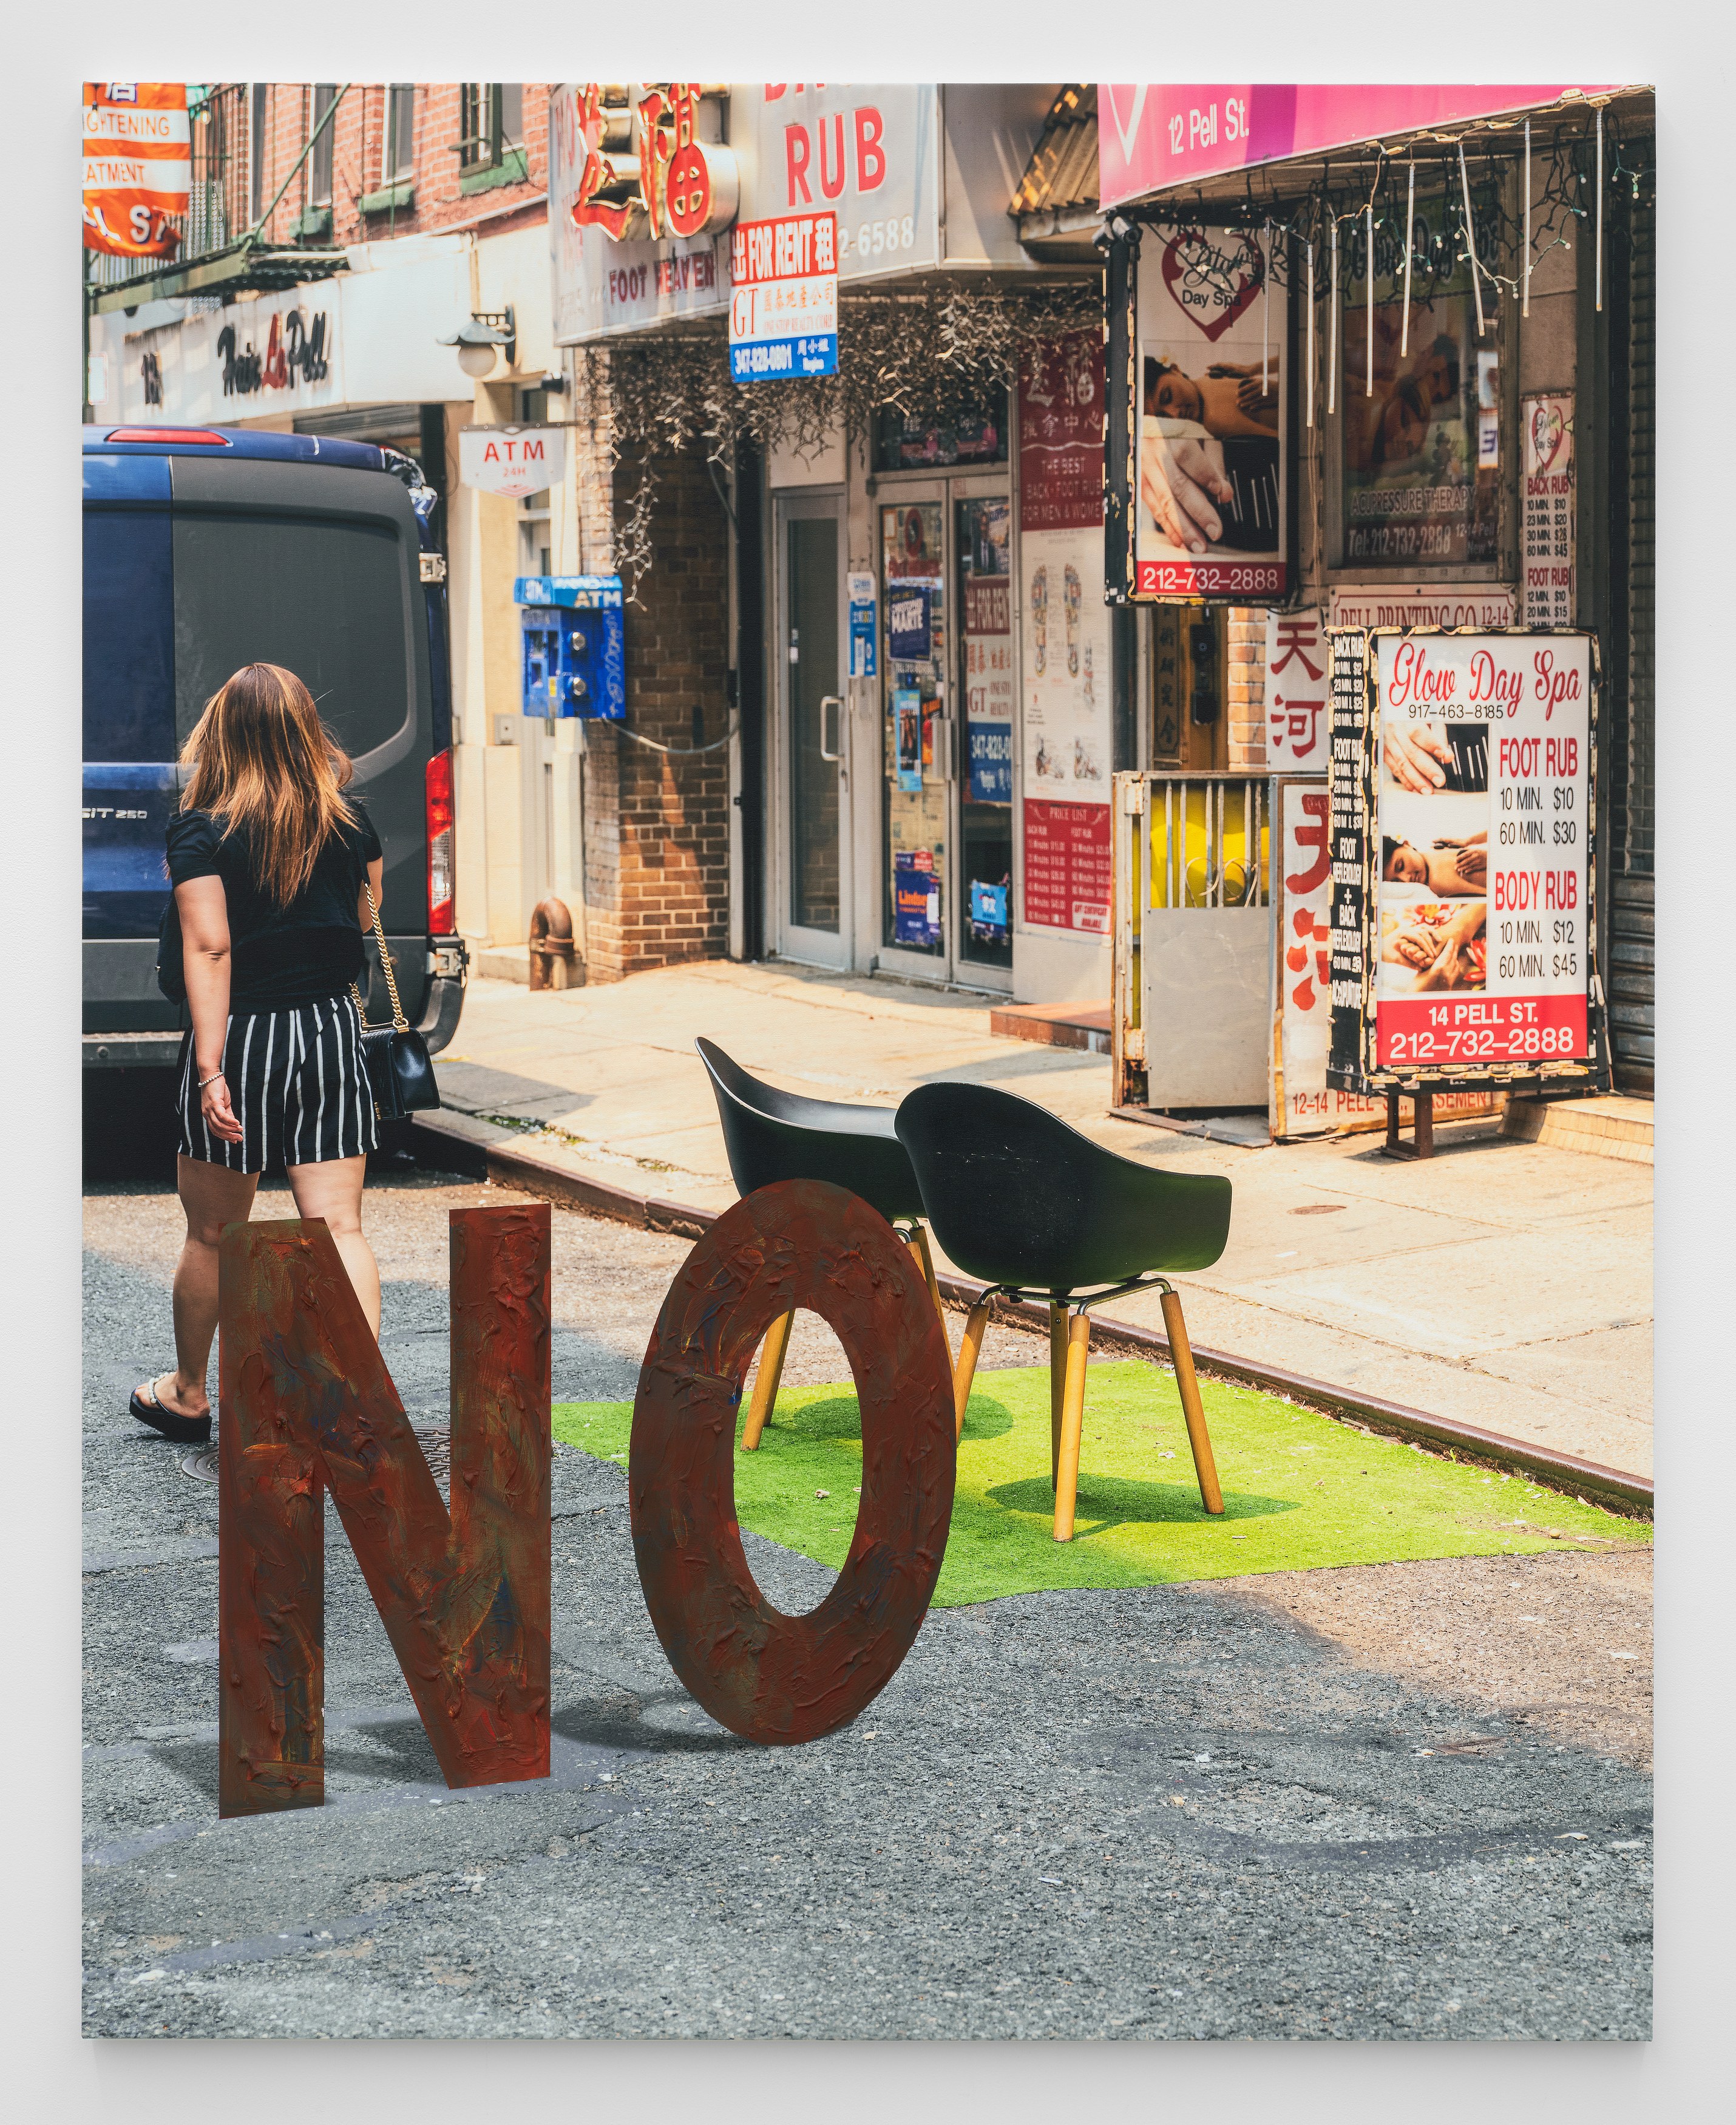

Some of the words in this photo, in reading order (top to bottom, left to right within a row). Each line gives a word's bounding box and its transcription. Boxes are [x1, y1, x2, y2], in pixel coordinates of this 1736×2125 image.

[1168, 114, 1184, 155] 12
[1189, 103, 1218, 151] Pell
[1225, 98, 1250, 141] St.
[785, 107, 886, 207] RUB
[748, 225, 773, 281] FOR
[775, 219, 813, 277] RENT
[815, 217, 835, 272] 租
[610, 264, 647, 304] FOOT
[1182, 290, 1209, 308] Day
[1213, 290, 1242, 307] Spa
[734, 288, 758, 337] GT
[485, 440, 544, 462] ATM
[503, 466, 527, 478] 24H
[1062, 456, 1086, 475] BEST
[1527, 477, 1550, 496] BACK
[1551, 475, 1569, 495] RUB
[1351, 488, 1423, 516] ACUPRESSURE
[1424, 485, 1476, 512] THERAPY
[1527, 499, 1534, 511] 10
[1535, 499, 1550, 511] MIN.
[1554, 498, 1566, 511] $10
[1536, 515, 1551, 526] MIN.
[1554, 514, 1567, 526] $20
[1527, 529, 1536, 542] 30
[1536, 529, 1551, 542] MIN.
[1536, 545, 1551, 557] MIN.
[1554, 543, 1568, 557] $45
[1144, 566, 1278, 590] 212-732-2888
[1527, 568, 1550, 587] FOOT
[1551, 566, 1569, 586] RUB
[574, 590, 622, 608] ATM
[1527, 591, 1534, 602] 12
[1535, 591, 1550, 602] MIN.
[1554, 591, 1566, 602] $10
[1377, 605, 1449, 626] PRINTING
[1481, 605, 1509, 625] 12-14
[1527, 607, 1536, 617] 20
[1536, 607, 1551, 617] MIN.
[1554, 606, 1567, 617] $15
[1334, 635, 1351, 658] BACK
[1351, 636, 1364, 658] RUB
[1270, 622, 1326, 758] 天河
[1389, 642, 1456, 706] Glow
[1470, 650, 1524, 718] Day
[1534, 650, 1582, 721] Spa
[971, 686, 988, 714] GT
[1409, 704, 1504, 719] 917-463-8185
[1334, 738, 1351, 761] FOOT
[1500, 737, 1541, 778] FOOT
[1546, 737, 1578, 777] RUB
[1500, 789, 1513, 811] 10
[1517, 787, 1543, 810] MIN.
[1553, 787, 1574, 811] $10
[115, 809, 147, 819] 250
[1500, 822, 1516, 845] 60
[1519, 821, 1546, 844] MIN.
[1553, 820, 1576, 845] $30
[1340, 837, 1357, 860] FOOT
[1496, 871, 1540, 911] BODY
[1546, 869, 1578, 910] RUB
[1339, 904, 1357, 928] BACK
[1500, 923, 1513, 943] 10
[1517, 922, 1543, 943] MIN.
[1553, 920, 1575, 943] $12
[1499, 956, 1515, 978] 60
[1519, 956, 1545, 977] MIN.
[1553, 953, 1577, 977] $45
[1429, 1006, 1449, 1026] 14
[1455, 1004, 1504, 1025] PELL
[1510, 1002, 1539, 1023] ST.
[1389, 1026, 1574, 1059] 212-732-2888
[1293, 1091, 1328, 1115] 12-14
[1337, 1090, 1374, 1112] PELL
[219, 1178, 957, 1819] NO
